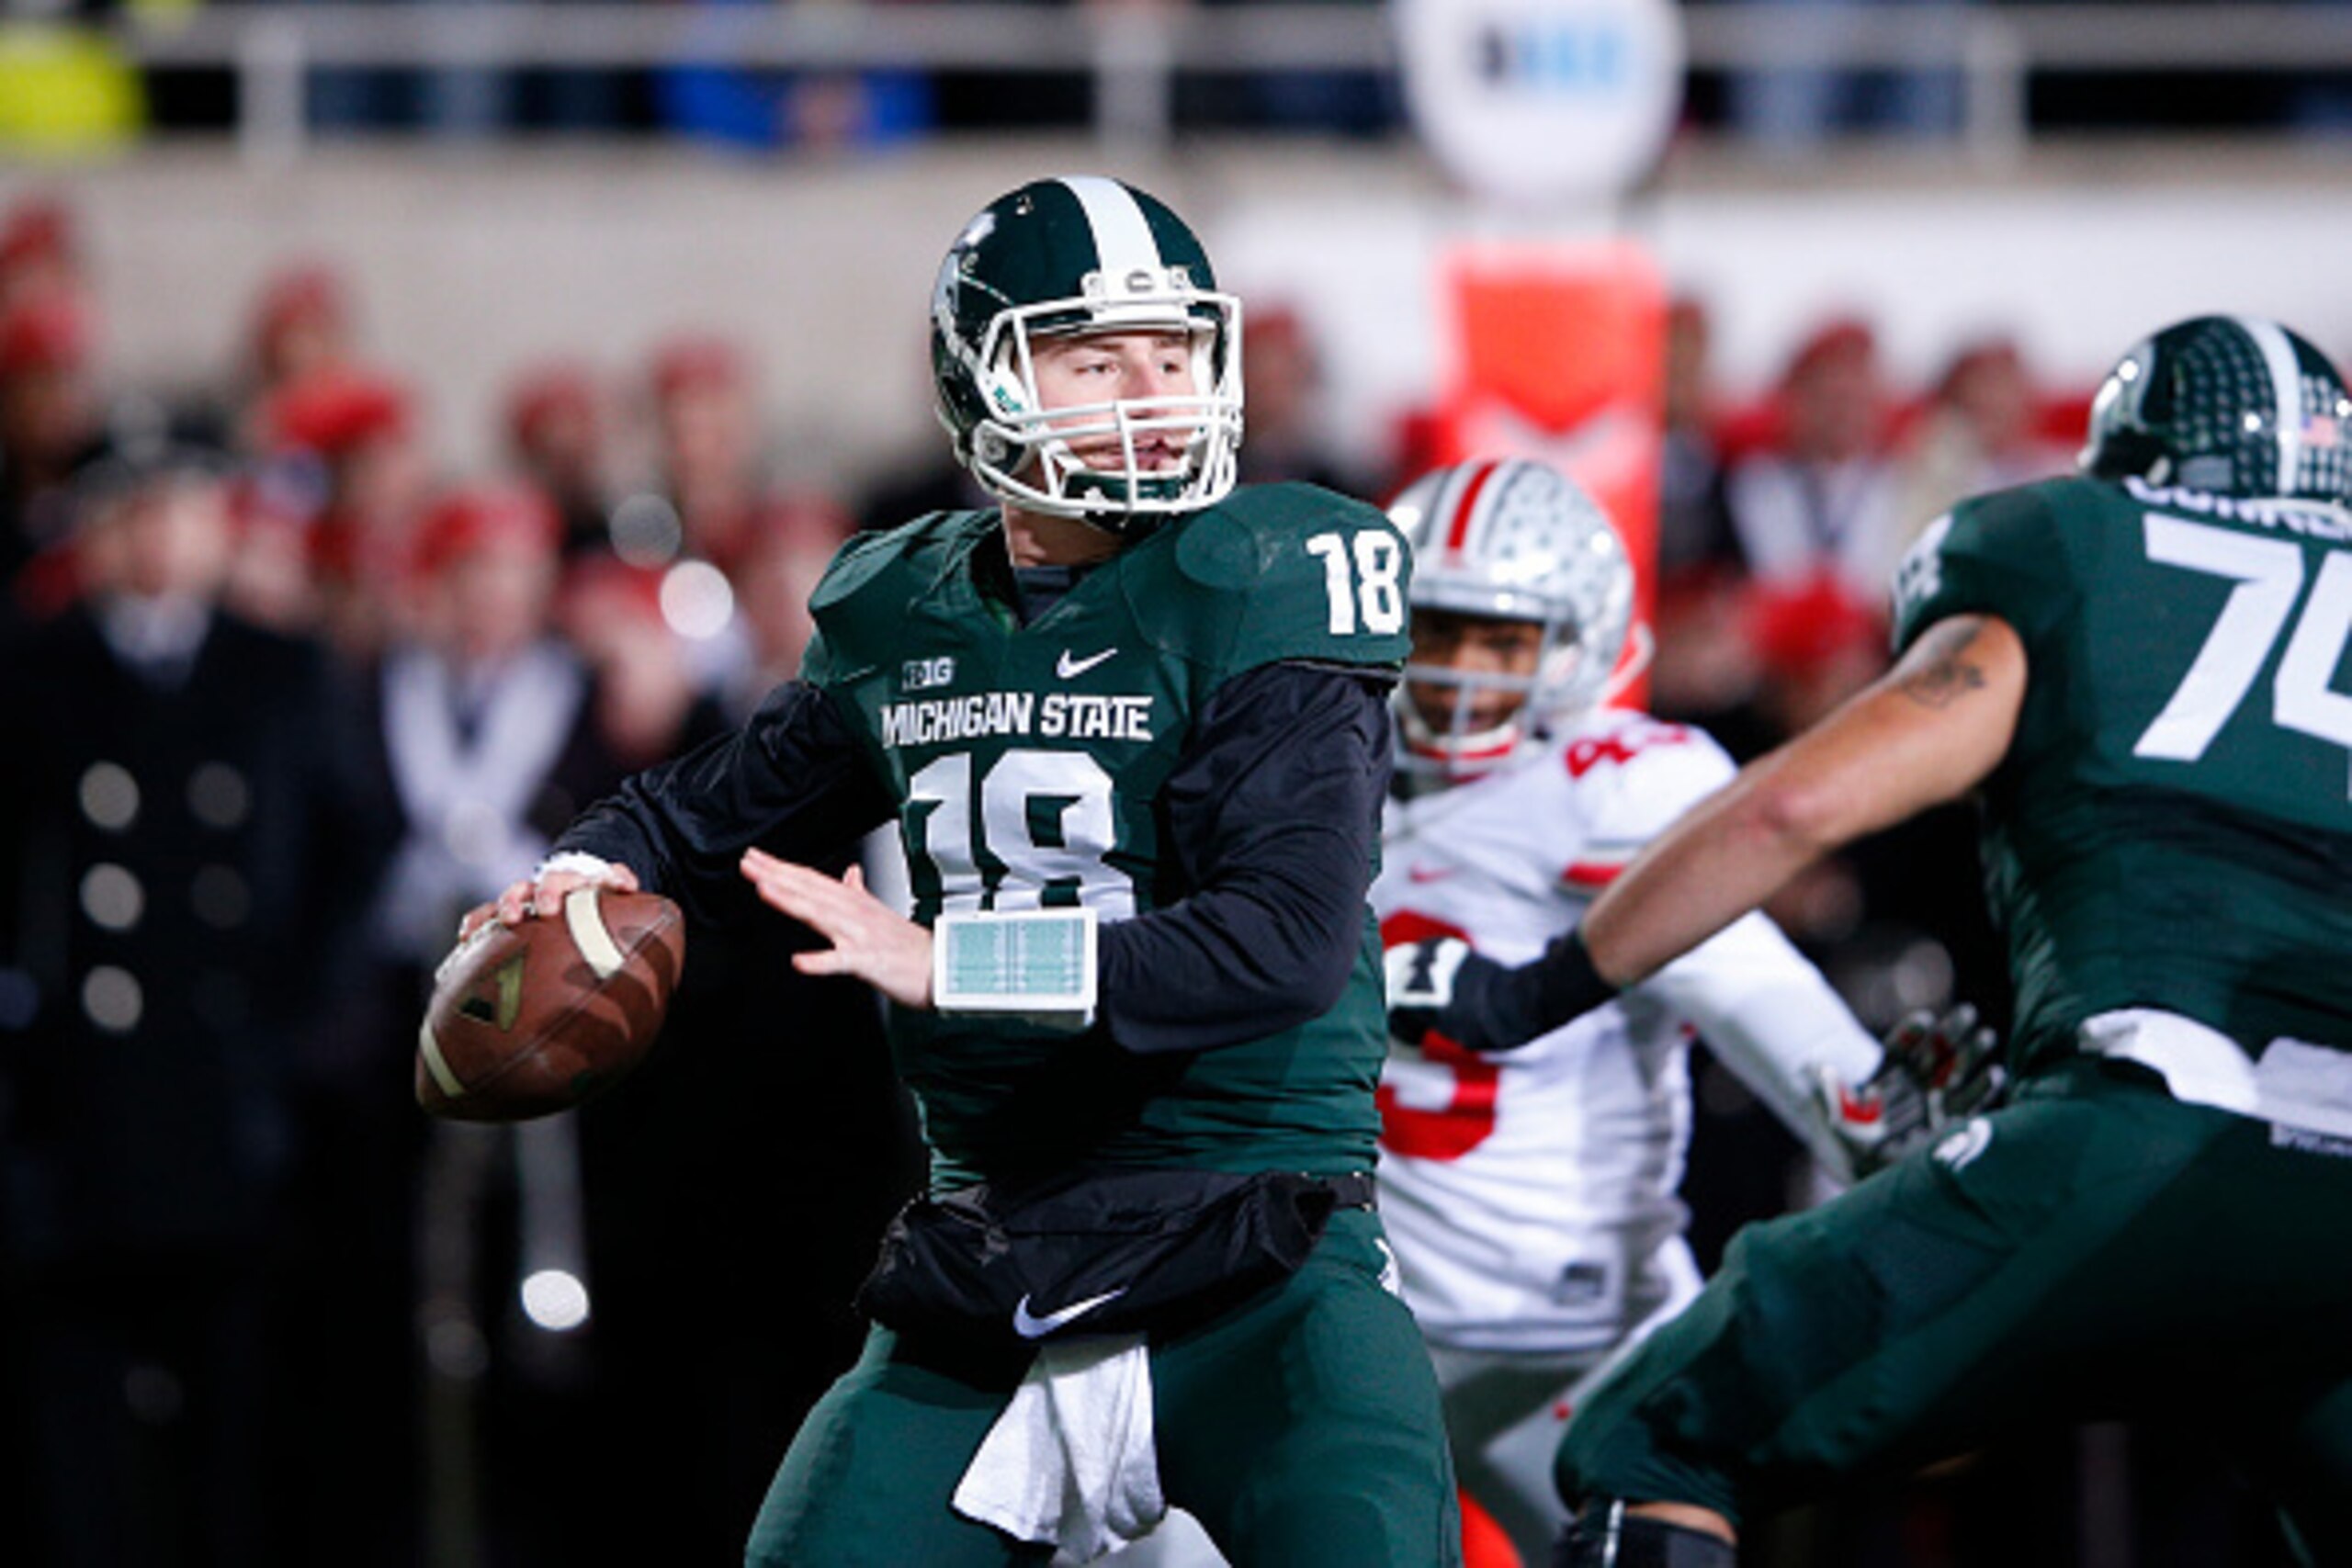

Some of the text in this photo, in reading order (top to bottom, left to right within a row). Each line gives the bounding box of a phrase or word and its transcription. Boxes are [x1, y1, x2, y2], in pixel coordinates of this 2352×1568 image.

[1306, 530, 1404, 635] 18
[881, 693, 1153, 749] MICHIGAN STATE
[910, 750, 1136, 920] 18
